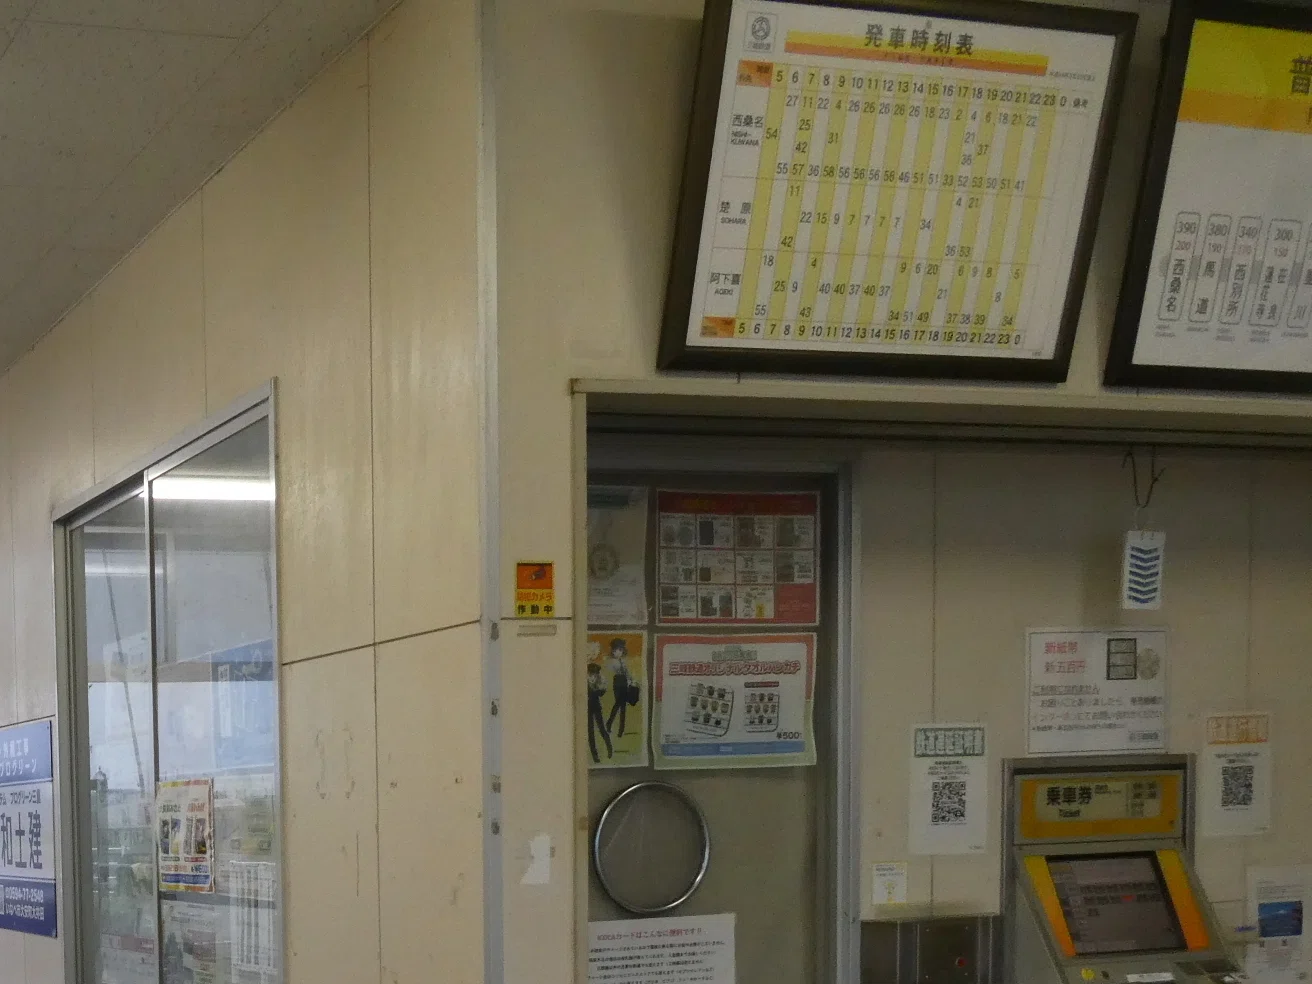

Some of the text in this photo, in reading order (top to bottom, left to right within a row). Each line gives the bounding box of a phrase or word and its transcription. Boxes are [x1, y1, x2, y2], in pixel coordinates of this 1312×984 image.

[865, 23, 974, 55] 発車時刻表
[775, 70, 783, 83] 5
[791, 71, 799, 83] 6
[808, 73, 815, 85] 7
[823, 74, 831, 86] 8
[838, 76, 845, 88] 9
[852, 77, 864, 89] 10
[868, 78, 879, 90] 11
[882, 79, 894, 92] 12
[897, 81, 909, 93] 13
[913, 82, 924, 94] 14
[928, 83, 939, 95] 15
[942, 85, 954, 96] 16
[957, 86, 969, 98] 17
[972, 87, 983, 99] 18
[987, 88, 998, 100] 19
[1000, 90, 1012, 102] 20
[1015, 91, 1027, 103] 21
[1029, 93, 1042, 105] 22
[1043, 94, 1056, 106] 23
[1060, 95, 1067, 107] 0
[786, 95, 799, 107] 27
[802, 96, 813, 108] 11
[818, 98, 829, 109] 22
[835, 100, 842, 110] 4
[848, 100, 860, 112] 26
[863, 101, 875, 113] 26
[894, 103, 905, 115] 26
[938, 107, 950, 120] 23
[955, 109, 962, 121] 2
[971, 110, 977, 121] 4
[1011, 113, 1022, 125] 21
[732, 114, 764, 128] 西桑名
[798, 119, 811, 131] 25
[765, 128, 778, 139] 54
[827, 132, 839, 144] 31
[795, 141, 808, 153] 42
[792, 163, 804, 175] 57
[913, 172, 923, 184] 51
[928, 173, 938, 185] 51
[957, 175, 969, 188] 52
[1000, 178, 1011, 190] 51
[789, 185, 800, 197] 11
[800, 211, 931, 230] 22 15 9 7 7 7 34
[781, 235, 793, 248] 42
[763, 255, 774, 267] 18
[811, 257, 817, 269] 4
[900, 262, 907, 273] 9
[915, 263, 921, 274] 6
[926, 263, 938, 275] 20
[773, 280, 786, 292] 25
[791, 281, 798, 293] 9
[819, 283, 831, 295] 40
[833, 283, 845, 295] 40
[849, 284, 860, 295] 37
[863, 284, 875, 296] 40
[879, 285, 890, 297] 37
[755, 304, 767, 316] 55
[800, 306, 812, 318] 43
[887, 310, 899, 322] 34
[916, 311, 929, 323] 49
[946, 312, 958, 324] 37
[739, 323, 1021, 345] 5 6 7 8 9 10 11 12 13 14 15 16 17 18 19 20 21 22 23 0
[517, 604, 553, 614] 作動中
[1046, 785, 1092, 806] 乗車券
